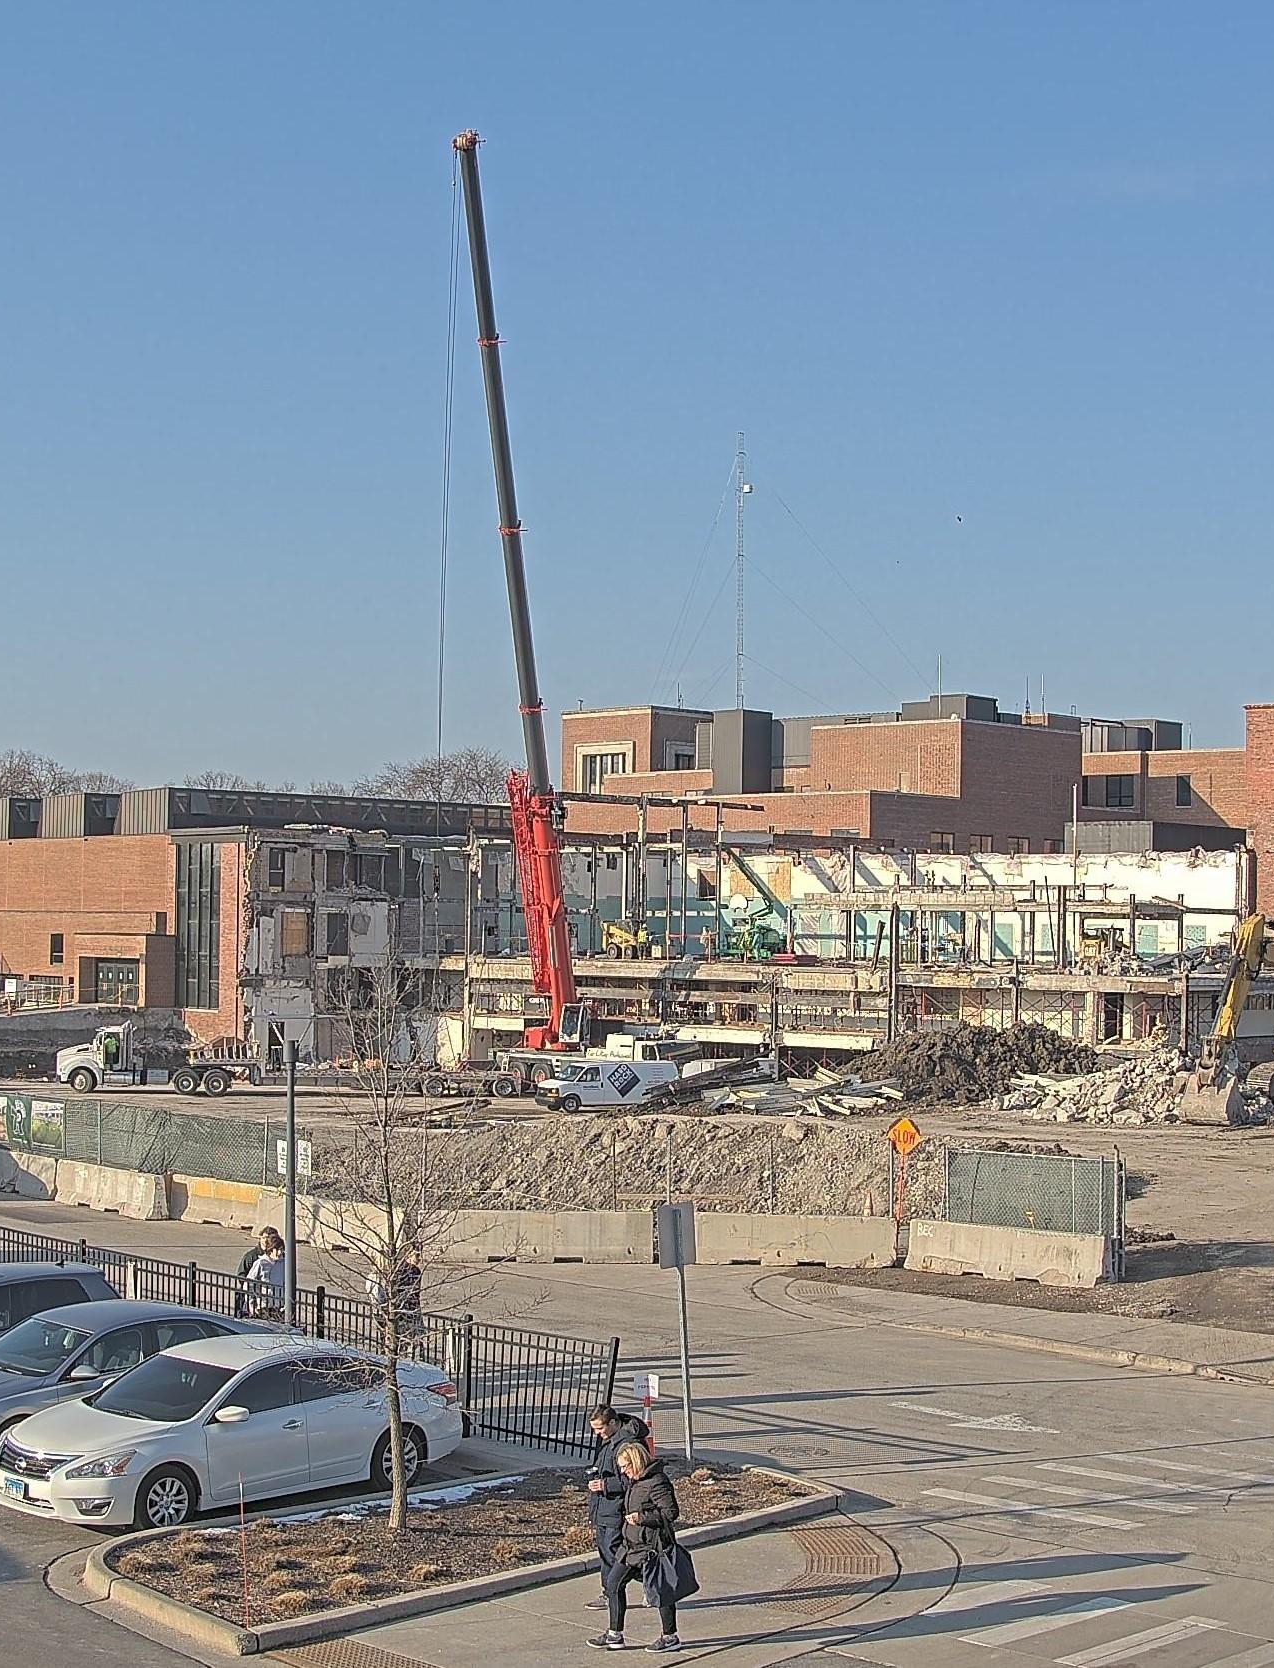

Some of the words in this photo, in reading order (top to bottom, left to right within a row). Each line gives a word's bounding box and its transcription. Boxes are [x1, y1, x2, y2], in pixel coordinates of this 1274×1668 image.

[609, 1064, 628, 1083] HARD
[613, 1068, 633, 1088] ROCK
[892, 1128, 916, 1145] SLOW
[917, 1222, 934, 1238] REC
